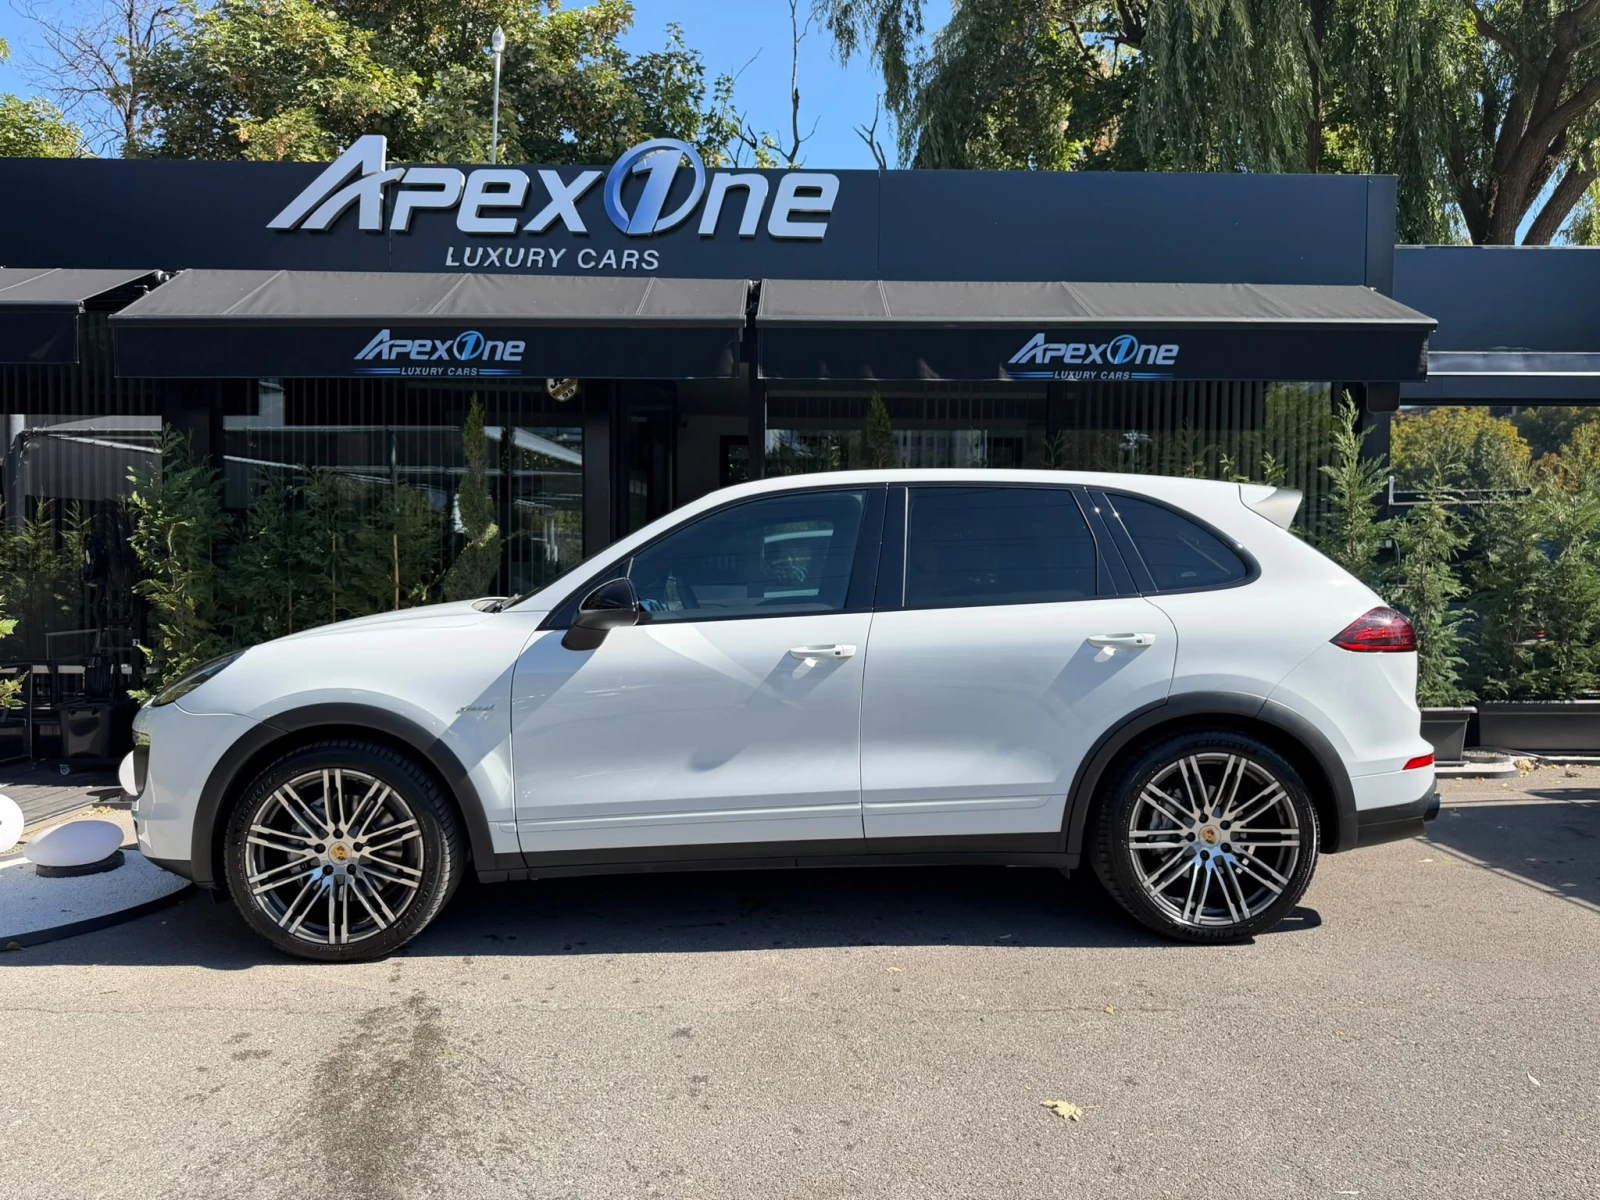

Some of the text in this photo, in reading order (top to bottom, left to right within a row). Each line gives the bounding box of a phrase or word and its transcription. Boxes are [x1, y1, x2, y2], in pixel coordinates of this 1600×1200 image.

[445, 247, 660, 270] LUXURY CARS
[401, 367, 478, 376] LUXURY CARS
[1054, 370, 1130, 380] LUXURY CARS
